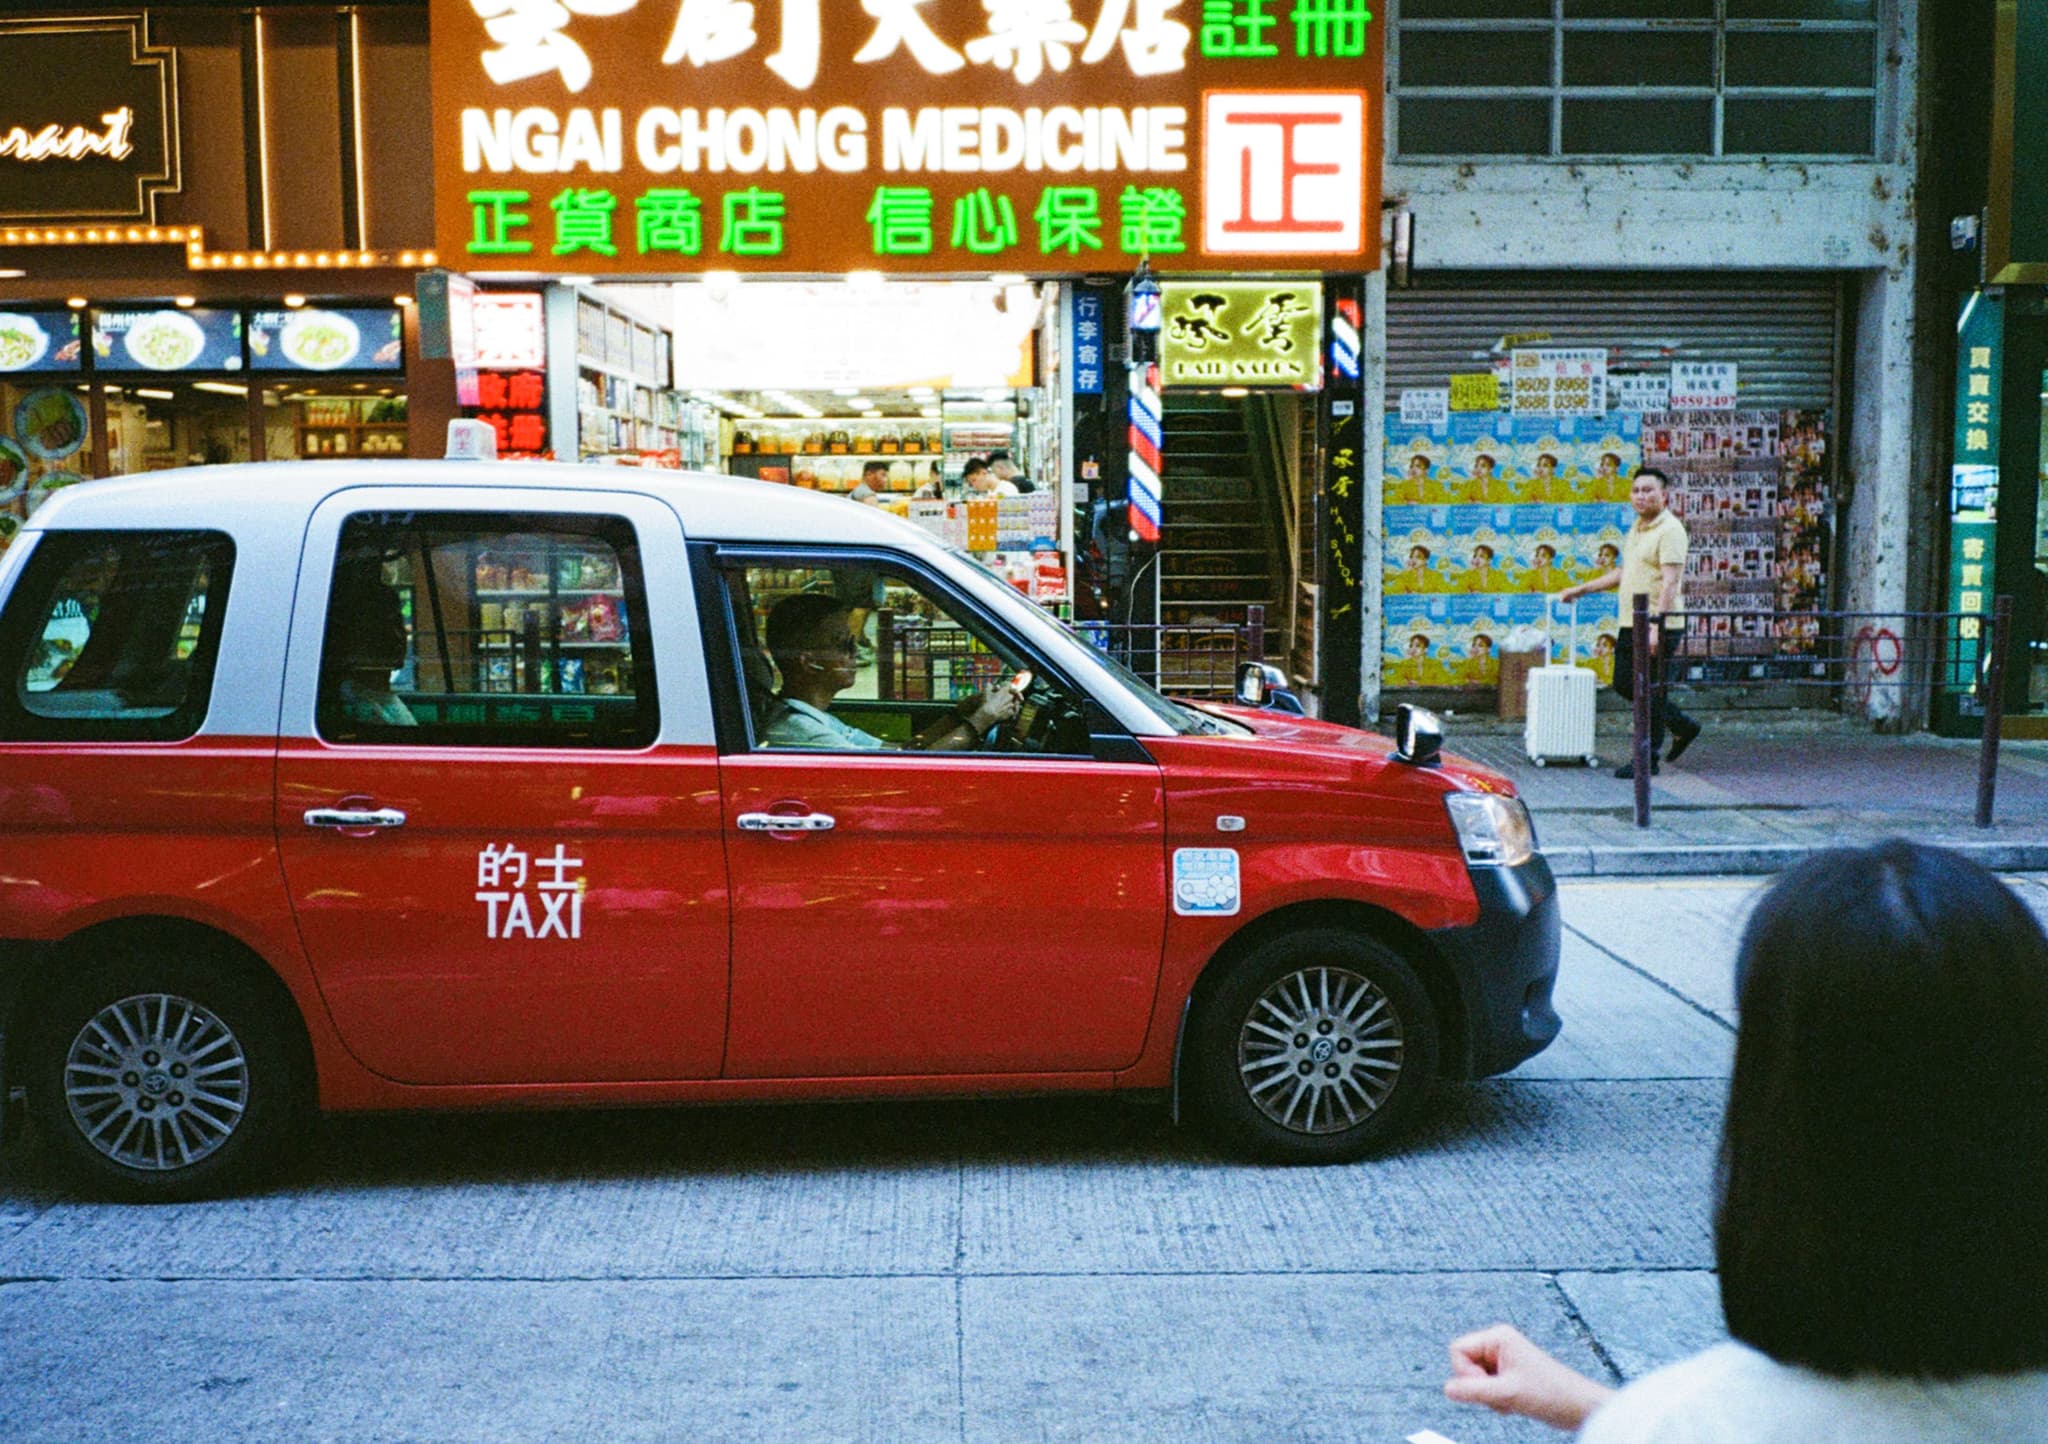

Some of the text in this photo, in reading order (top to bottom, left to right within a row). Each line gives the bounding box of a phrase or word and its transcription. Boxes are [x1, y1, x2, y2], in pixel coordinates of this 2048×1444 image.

[460, 105, 1187, 173] NGAI CHONG MEDICINE
[1221, 111, 1346, 234] 正
[465, 184, 1186, 257] 正貨商店 信心保證
[1078, 296, 1098, 390] 行李寄存
[1232, 361, 1303, 377] SALON
[1330, 539, 1355, 587] SALON
[477, 842, 583, 889] 的士
[475, 891, 583, 940] TAXI
